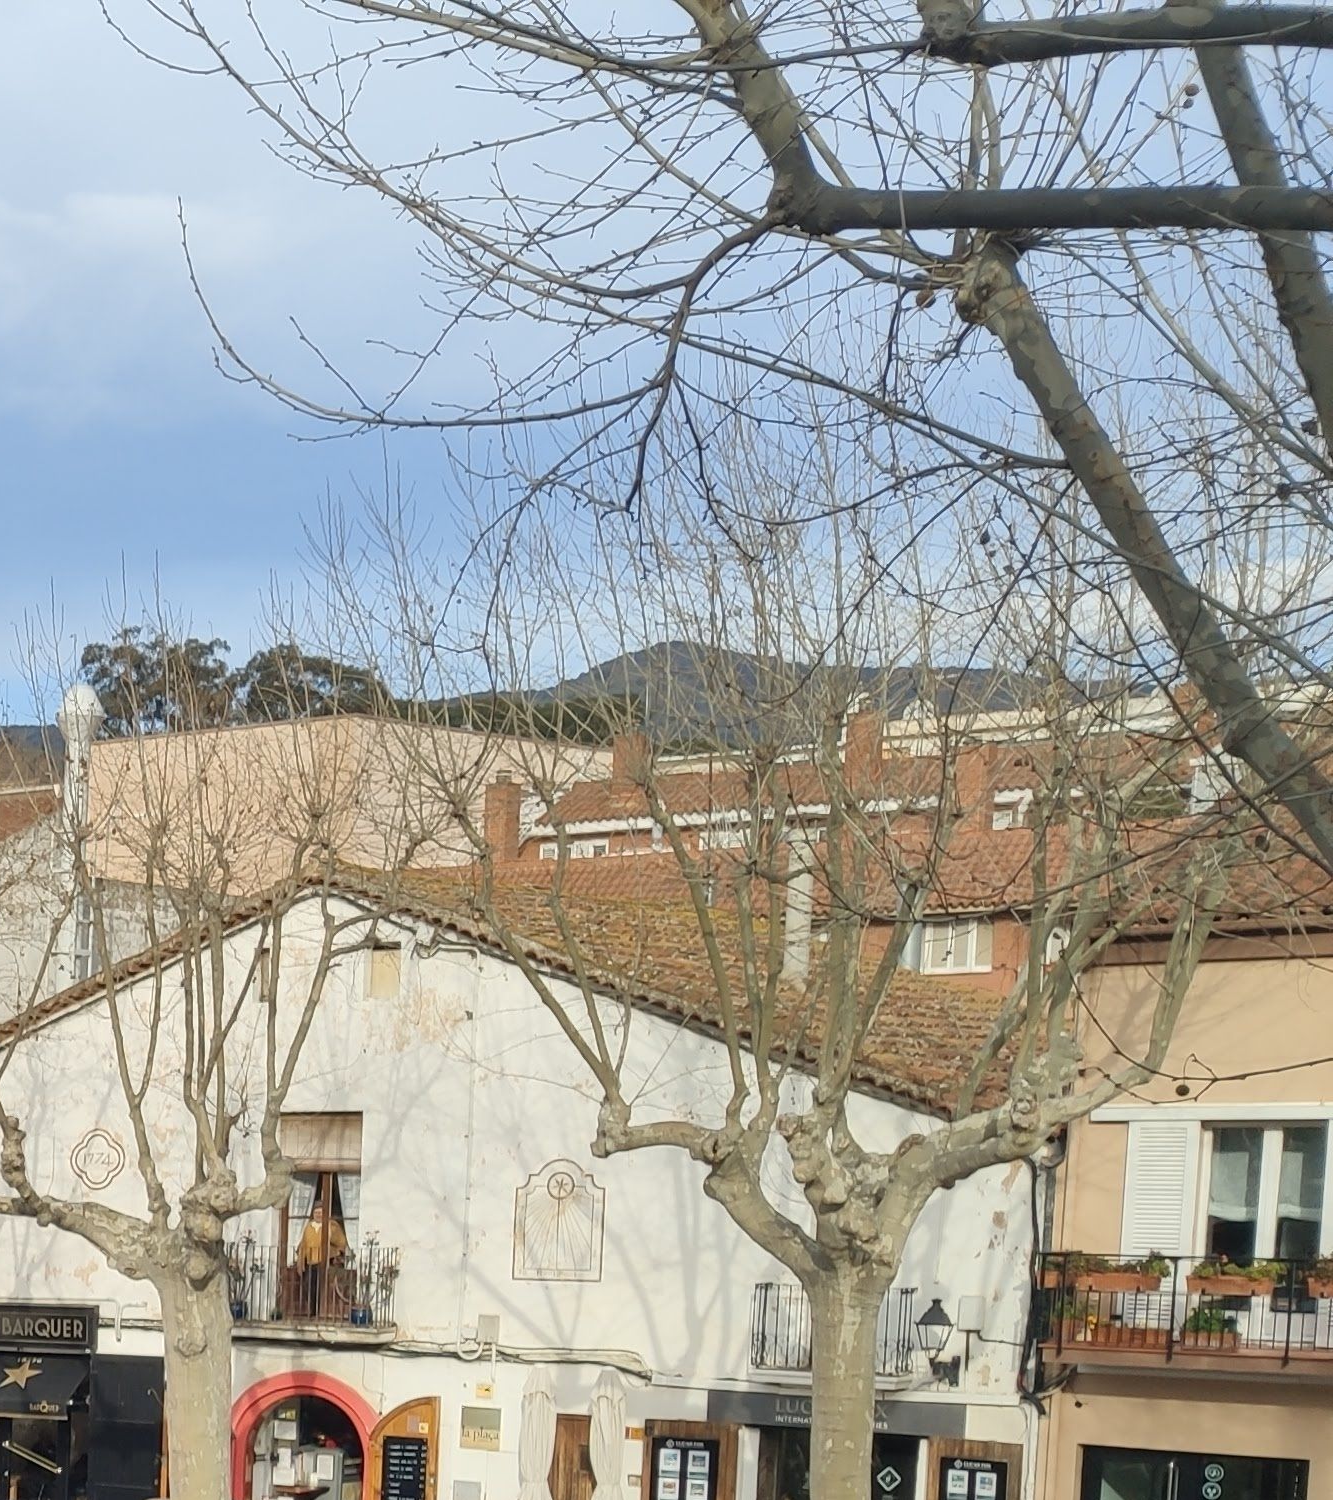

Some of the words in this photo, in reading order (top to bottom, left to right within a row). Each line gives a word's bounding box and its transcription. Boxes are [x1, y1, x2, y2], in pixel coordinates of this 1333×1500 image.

[83, 1152, 113, 1166] 1774
[2, 1317, 83, 1339] BARQUER
[461, 1425, 470, 1438] la
[473, 1425, 499, 1442] plaça
